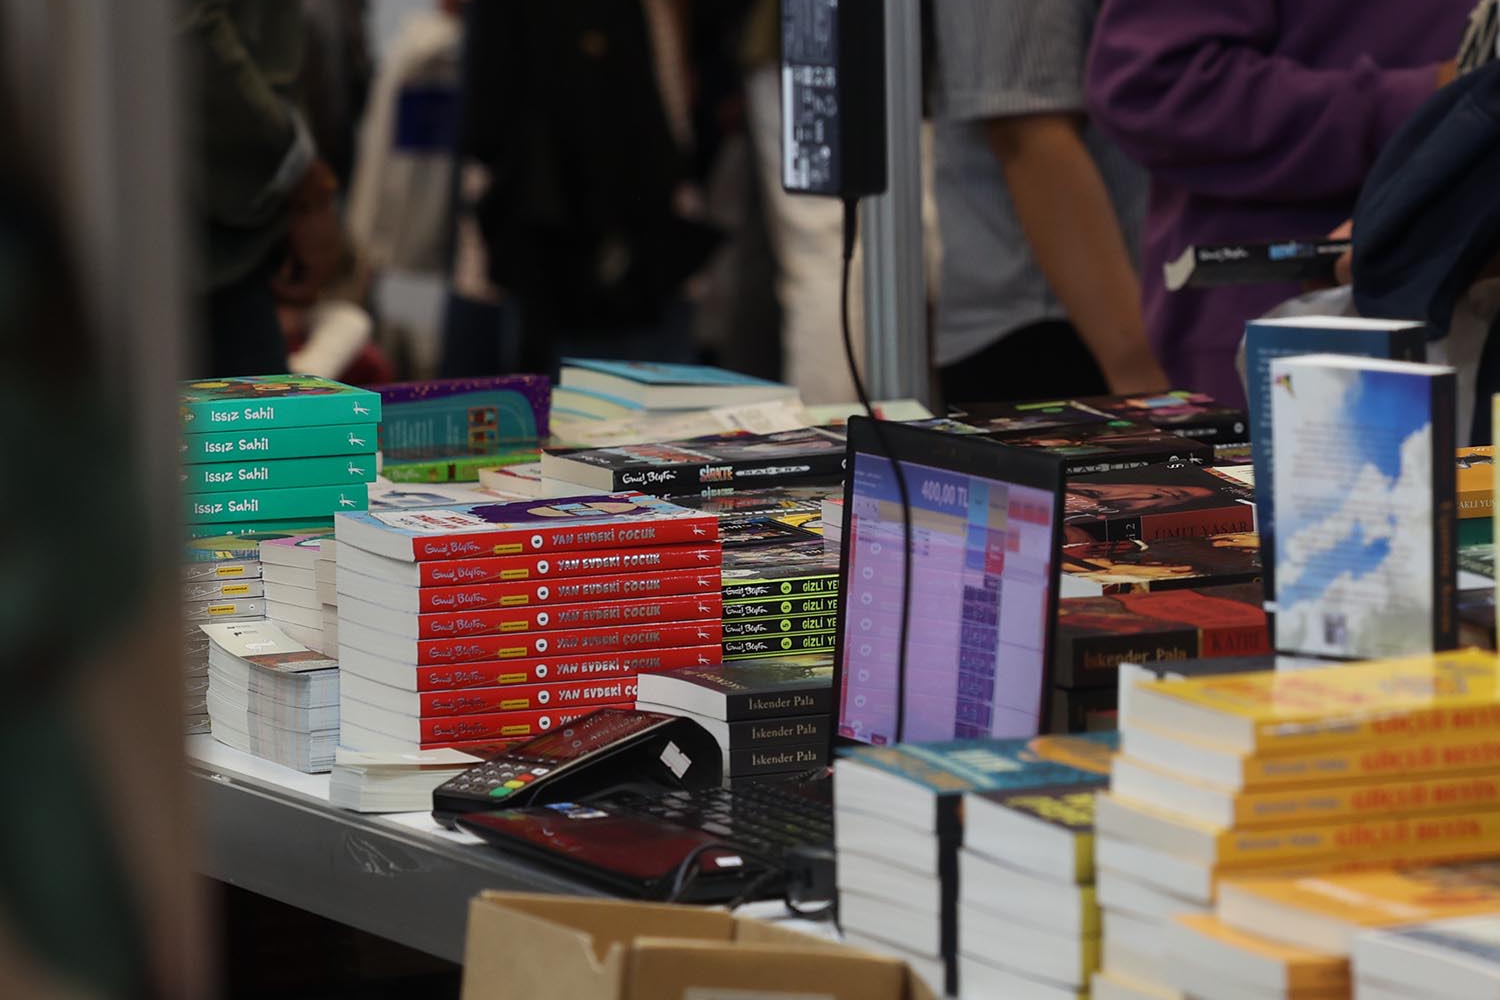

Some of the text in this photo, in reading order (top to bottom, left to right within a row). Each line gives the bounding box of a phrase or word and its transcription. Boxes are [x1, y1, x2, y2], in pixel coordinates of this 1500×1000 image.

[211, 407, 274, 422] Issız Sahil
[205, 438, 269, 453] Issız Sahil
[205, 467, 268, 483] Issız Sahil
[622, 470, 647, 485] Enid
[647, 470, 677, 483] Blyton
[228, 498, 259, 512] Sahil
[957, 487, 969, 508] TL
[1457, 500, 1477, 509] AKLI
[552, 534, 574, 545] YAN
[577, 528, 615, 544] EVDEKİ
[619, 527, 656, 541] ÇOCUK
[558, 559, 579, 571] YAN
[582, 554, 620, 569] EVDEKİ
[624, 553, 661, 567] ÇOCUK
[558, 585, 579, 597] YAN
[582, 579, 620, 595] EVDEKİ
[624, 579, 661, 593] ÇOCUK
[803, 579, 824, 592] GİZLİ
[827, 578, 839, 590] YE
[803, 599, 824, 612] GİZLİ
[558, 611, 579, 623] YAN
[582, 605, 620, 620] EVDEKİ
[624, 605, 661, 619] ÇOCUK
[802, 617, 823, 630] GİZLİ
[623, 631, 660, 645] ÇOCUK
[803, 635, 824, 648] GİZLİ
[556, 663, 578, 675] YAN
[581, 658, 619, 672] EVDEKİ
[623, 657, 661, 671] ÇOCUK
[559, 689, 580, 700] YAN
[584, 683, 621, 698] EVDEKİ
[749, 695, 814, 711] İskender Pala
[752, 723, 817, 739] İskender Pala
[752, 750, 817, 766] İskender Pala
